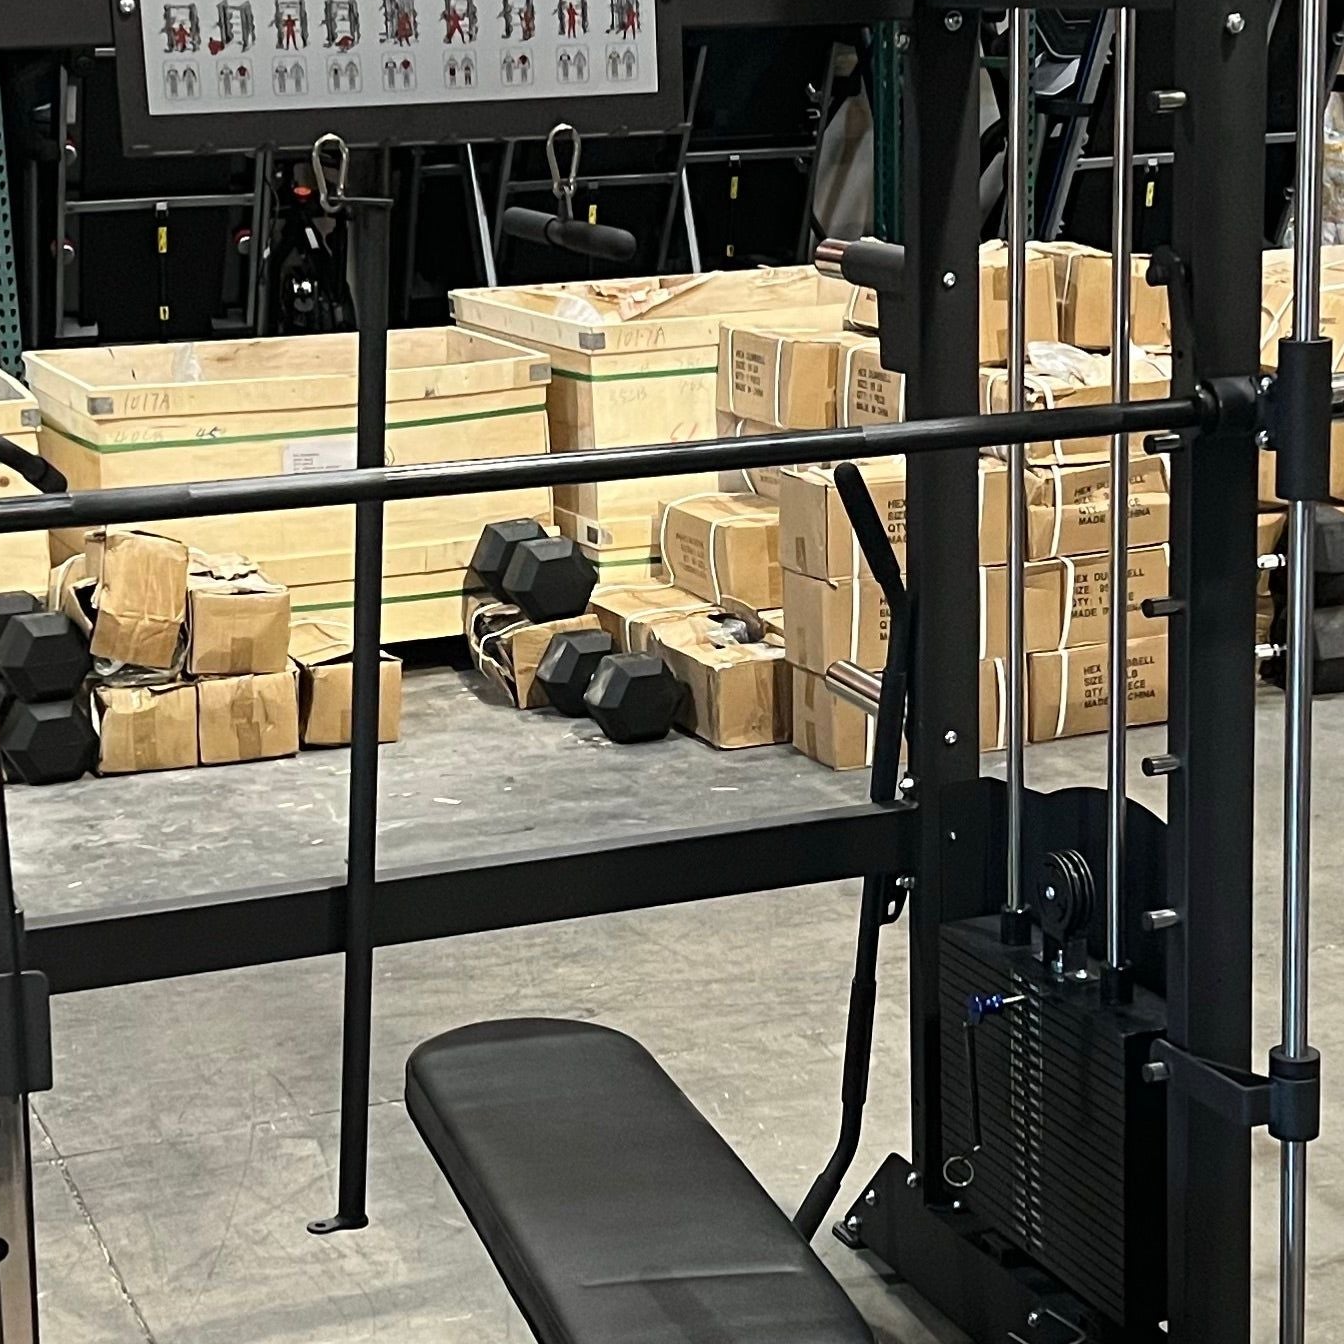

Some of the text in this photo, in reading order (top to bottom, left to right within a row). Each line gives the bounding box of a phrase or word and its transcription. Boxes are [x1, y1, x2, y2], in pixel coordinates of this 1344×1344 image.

[1078, 514, 1106, 526] MADE
[1083, 663, 1102, 675] HEX
[1083, 675, 1104, 687] SIZE
[1084, 687, 1103, 698] QTY
[1083, 697, 1108, 709] MADE
